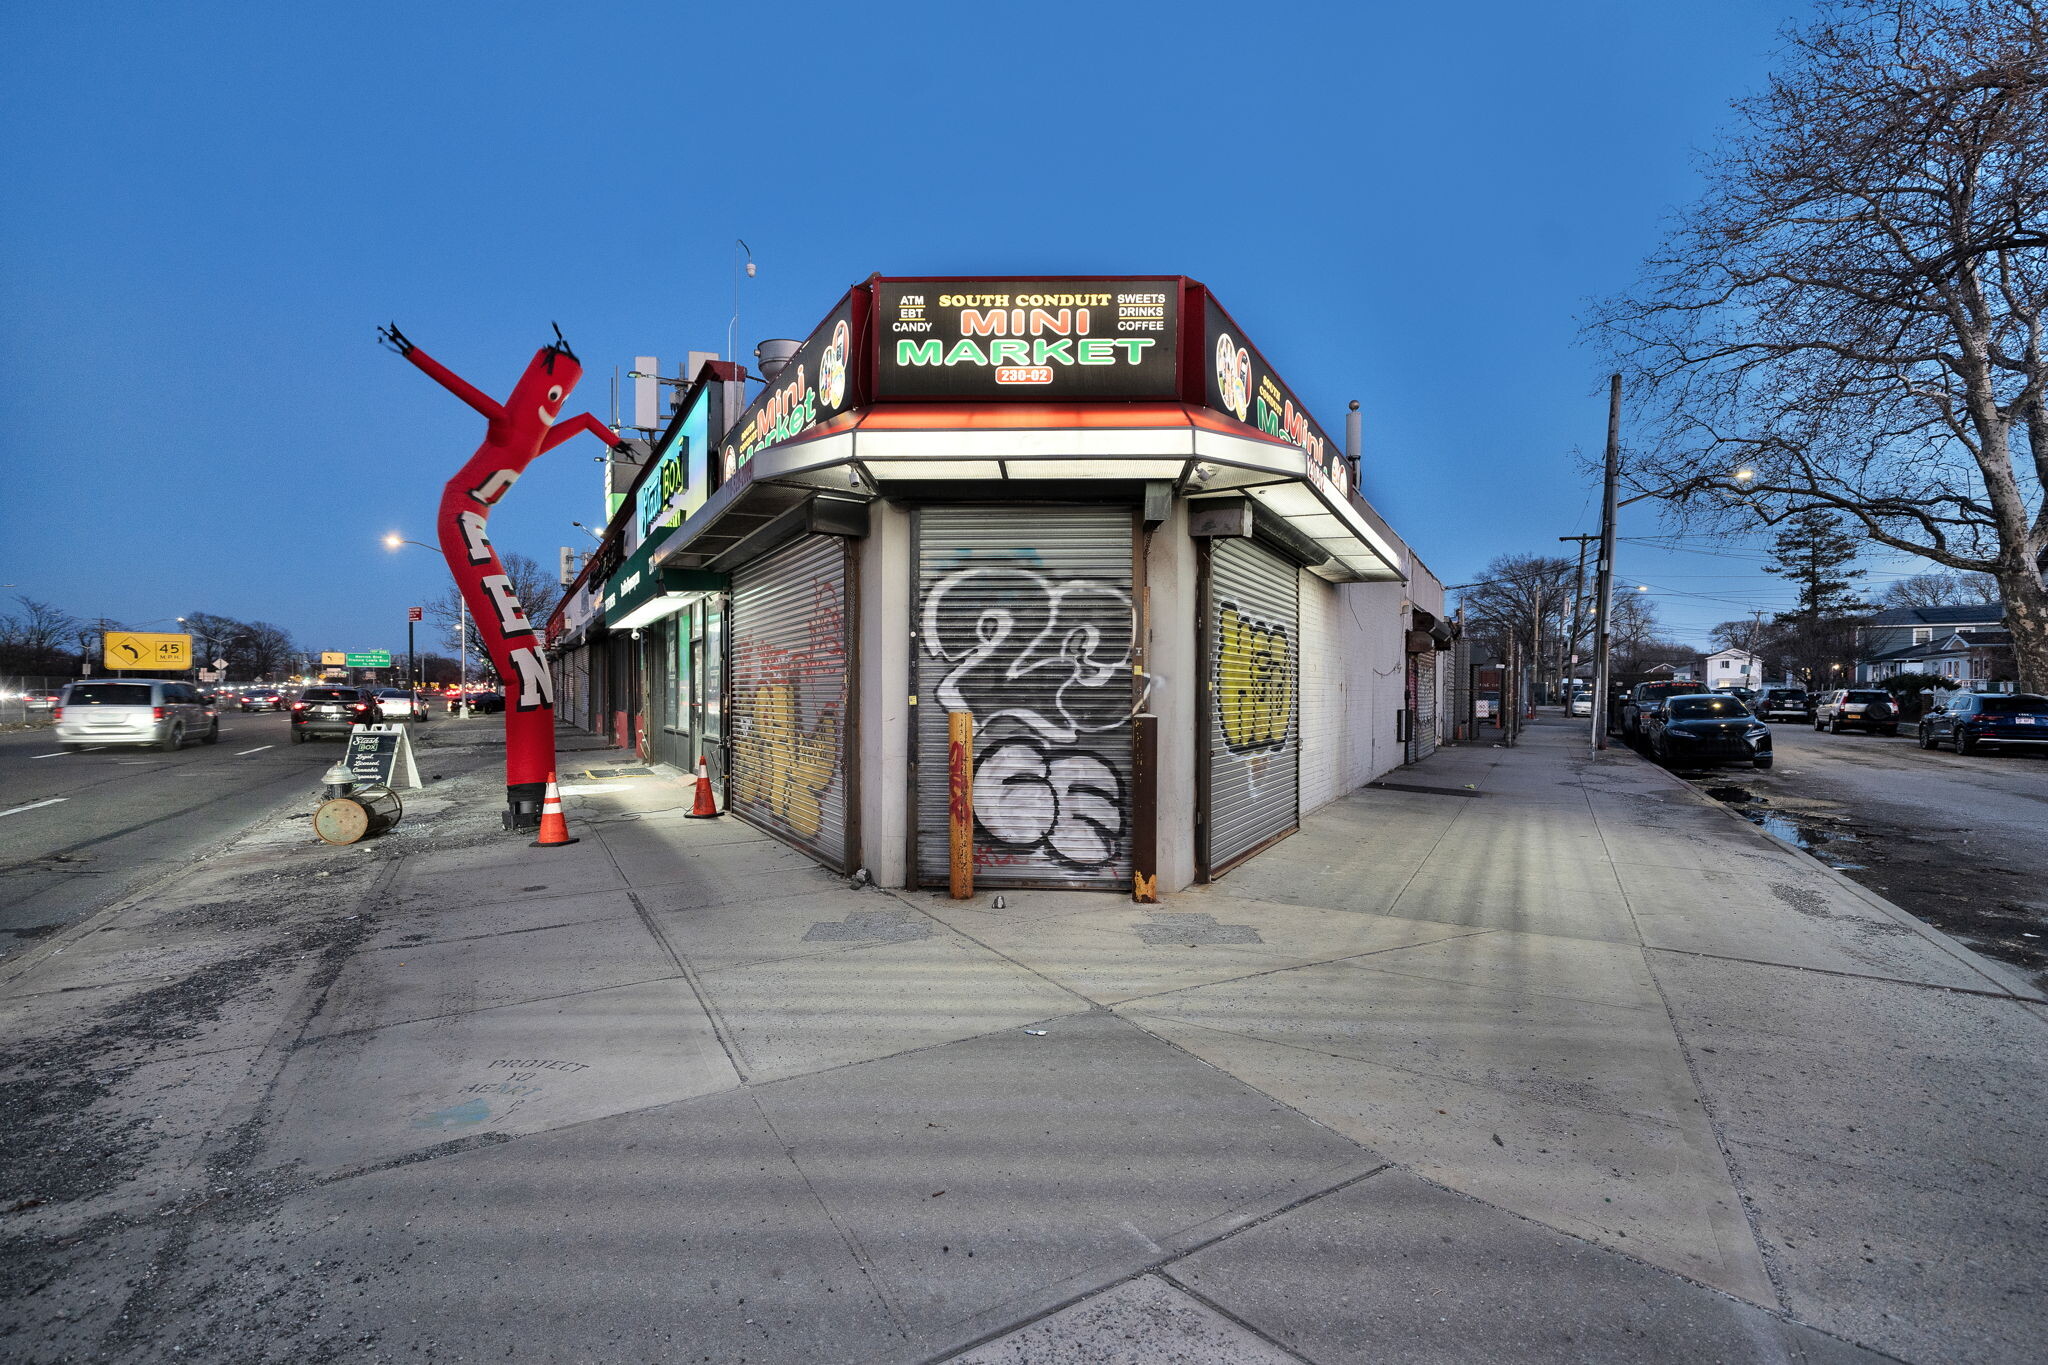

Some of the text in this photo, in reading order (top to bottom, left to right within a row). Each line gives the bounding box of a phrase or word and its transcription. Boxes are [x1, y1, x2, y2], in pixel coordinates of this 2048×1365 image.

[900, 295, 924, 306] ATM
[939, 294, 1112, 307] SOUTH CONDUIT
[1117, 293, 1166, 304] SWEETS
[900, 308, 924, 319] EBT
[1118, 306, 1164, 317] DRINKS
[892, 322, 933, 333] CANDY
[960, 308, 1090, 337] MINI
[1117, 321, 1164, 331] COFFEE
[896, 338, 1156, 366] MARKET
[1001, 369, 1048, 382] 230-02
[757, 364, 805, 441] Mini
[1284, 399, 1324, 466] Mini
[159, 643, 180, 654] 45
[488, 1059, 590, 1073] PROTECT
[506, 1072, 537, 1082] YO
[458, 1083, 543, 1097] HEART
